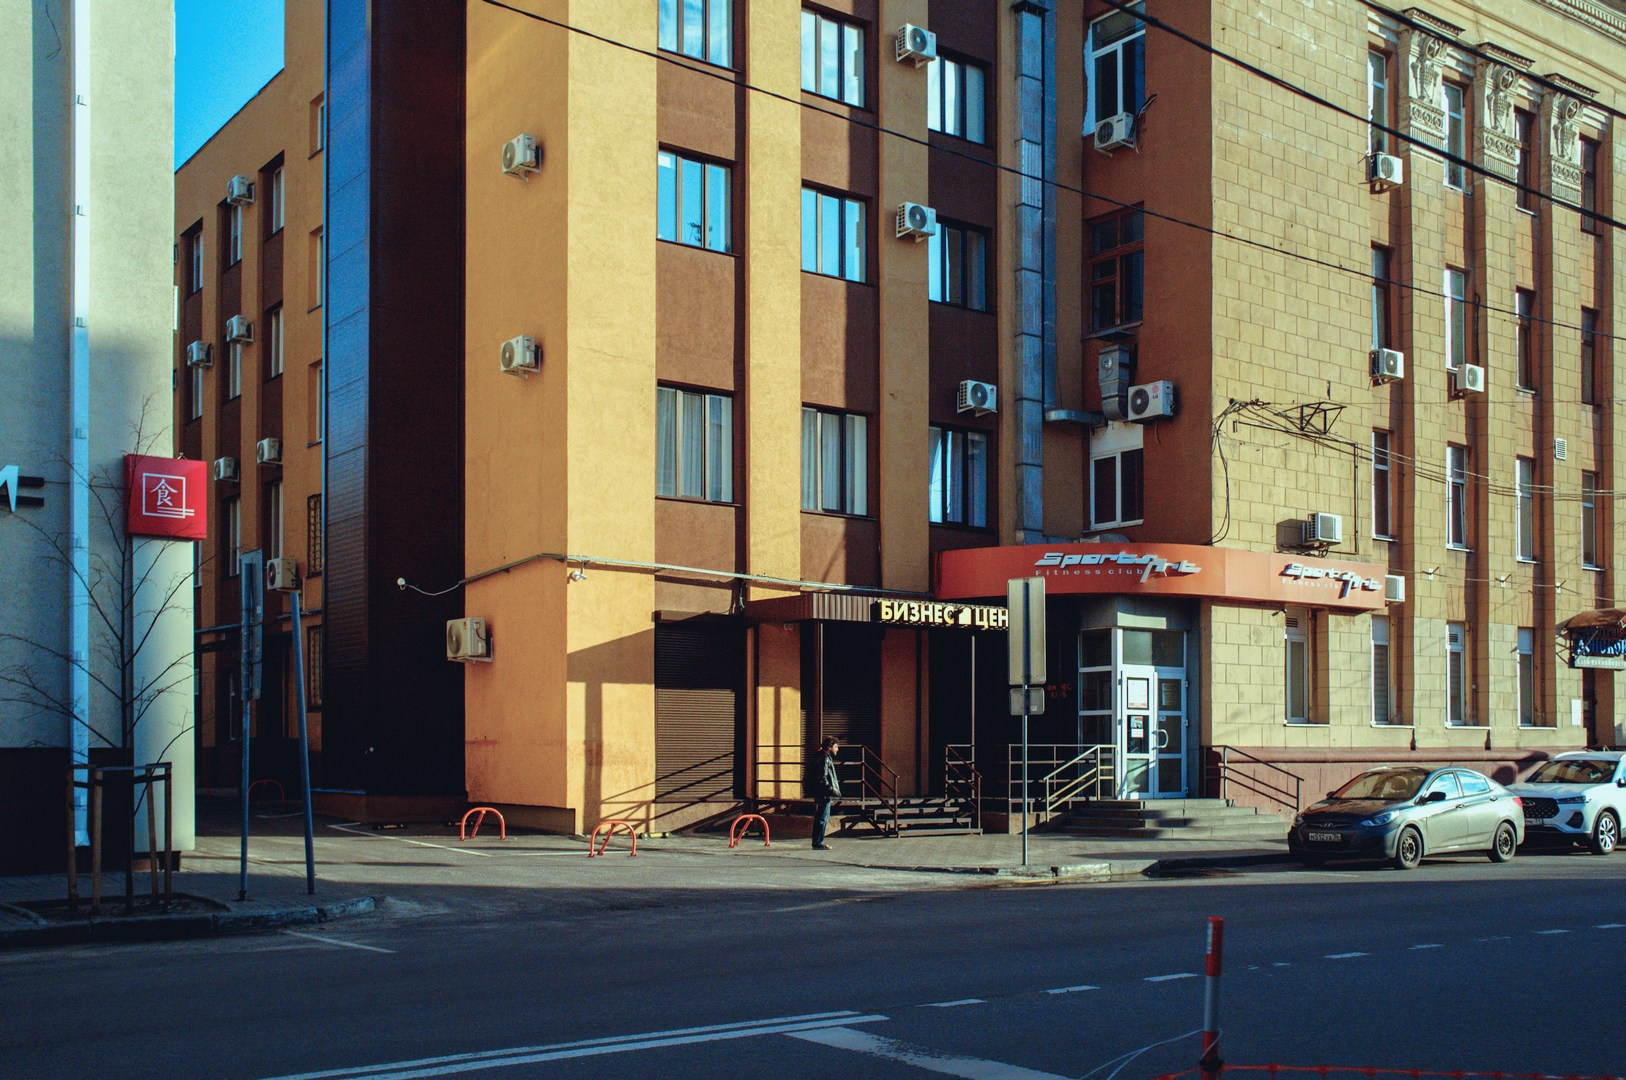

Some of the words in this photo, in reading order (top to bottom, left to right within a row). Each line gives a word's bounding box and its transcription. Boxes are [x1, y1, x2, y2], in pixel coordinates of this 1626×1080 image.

[150, 479, 178, 507] 食
[1108, 567, 1143, 575] club
[881, 600, 955, 625] БИЗНЕС
